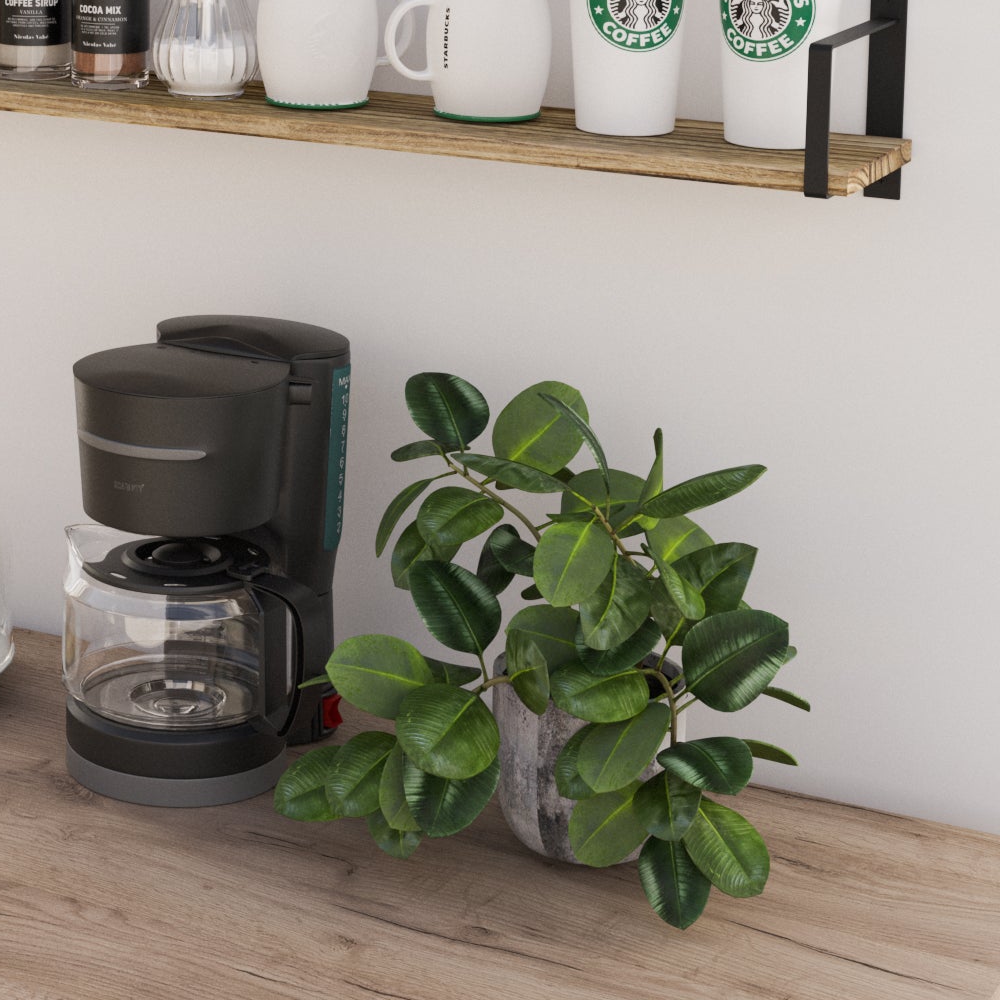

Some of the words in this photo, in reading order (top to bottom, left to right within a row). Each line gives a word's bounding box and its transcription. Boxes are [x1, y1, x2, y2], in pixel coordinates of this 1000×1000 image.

[79, 4, 104, 14] COCOA
[105, 6, 122, 15] MIX
[443, 7, 451, 69] STARBUCKS
[602, 21, 672, 47] COFFEE
[726, 27, 795, 57] COFFEE
